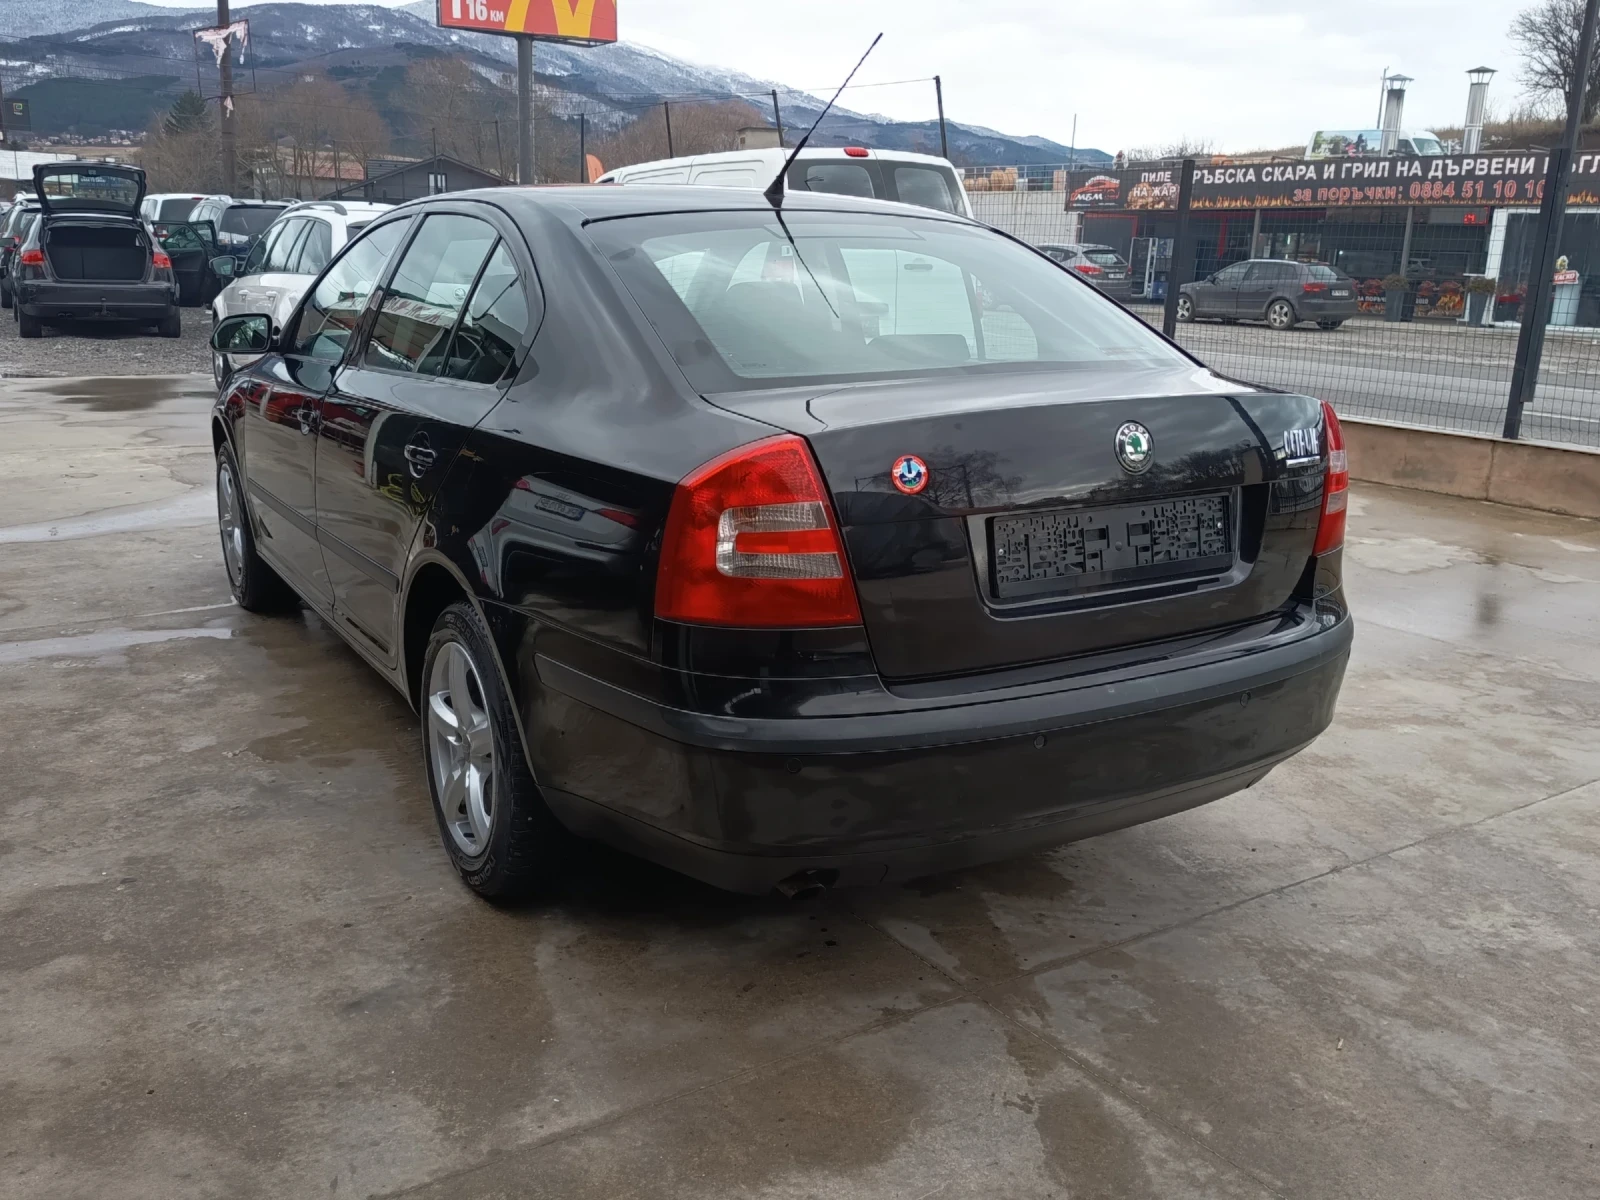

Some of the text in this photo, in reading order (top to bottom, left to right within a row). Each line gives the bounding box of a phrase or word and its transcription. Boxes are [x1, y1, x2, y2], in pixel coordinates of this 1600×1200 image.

[1141, 171, 1172, 183] ПИЛЕ
[1262, 165, 1317, 182] СКАРА
[1323, 163, 1335, 179] И
[1341, 162, 1389, 178] ГРИЛ
[1396, 160, 1422, 177] НА
[1428, 156, 1535, 179] ДЪРВЕНИ
[1133, 186, 1176, 197] НА ЖАР
[1293, 189, 1312, 202] за
[1317, 185, 1403, 203] поръчки:
[1409, 181, 1455, 199] 0884
[1461, 180, 1484, 198] 51
[1493, 180, 1517, 198] 10
